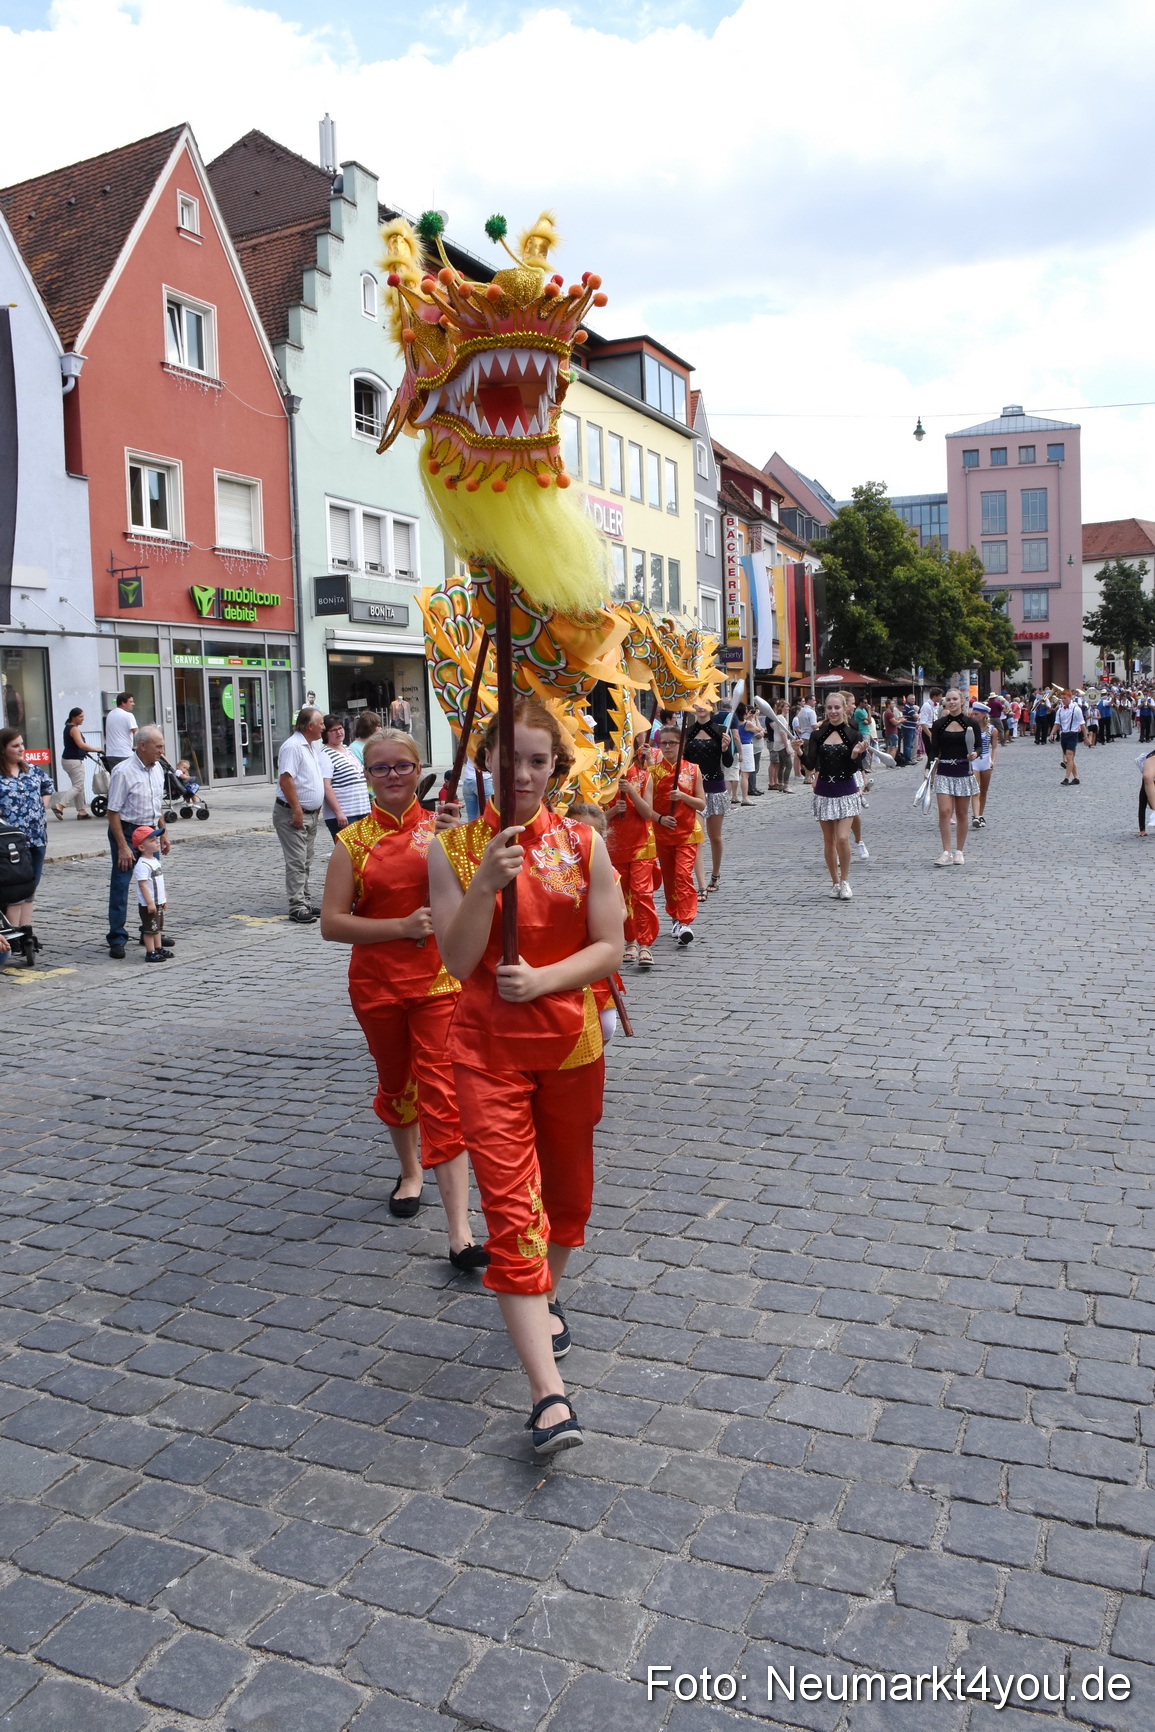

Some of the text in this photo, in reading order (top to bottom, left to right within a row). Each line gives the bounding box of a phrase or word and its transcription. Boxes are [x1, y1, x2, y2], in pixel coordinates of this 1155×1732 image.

[223, 587, 281, 605] mobilcom
[224, 604, 259, 621] debitel
[1013, 631, 1050, 640] arkasse
[174, 655, 200, 665] GRAVIS
[25, 752, 41, 761] SALE
